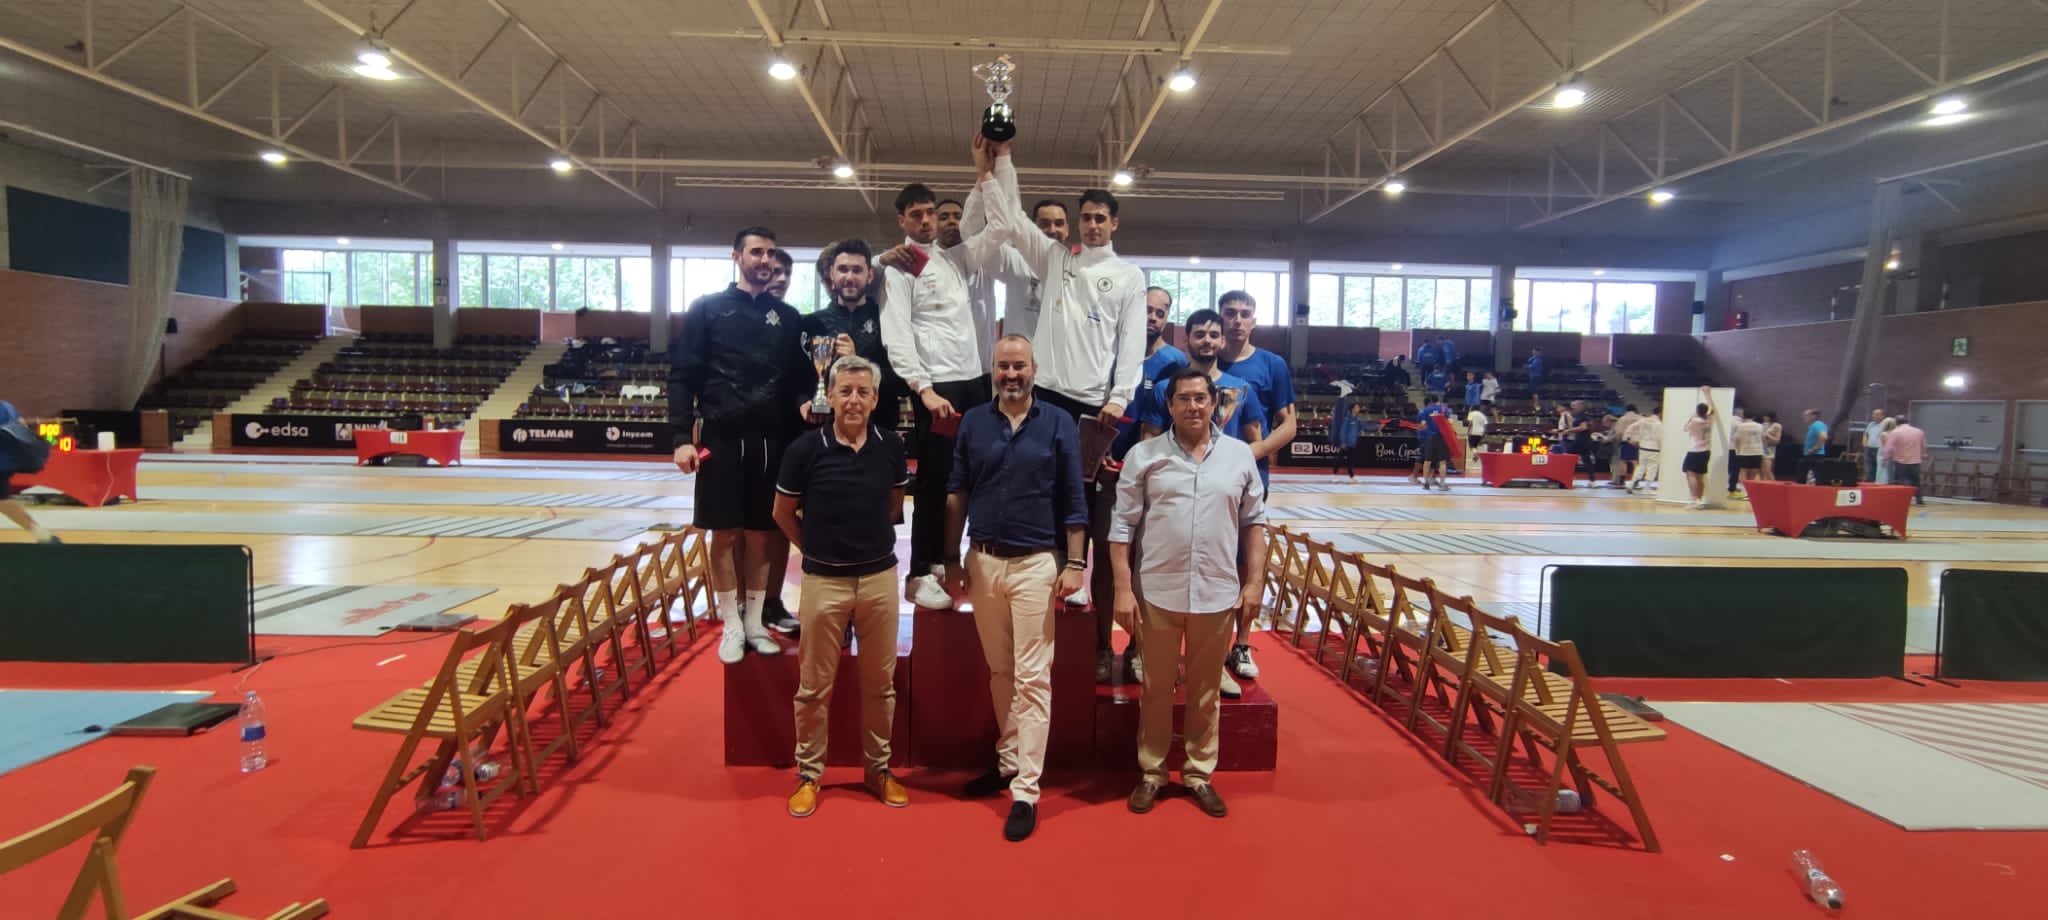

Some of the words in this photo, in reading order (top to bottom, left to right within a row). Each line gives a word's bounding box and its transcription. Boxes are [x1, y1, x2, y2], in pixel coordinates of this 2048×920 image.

[271, 421, 309, 437] edsa
[529, 429, 574, 438] TELMAN
[1848, 491, 1857, 503] 9
